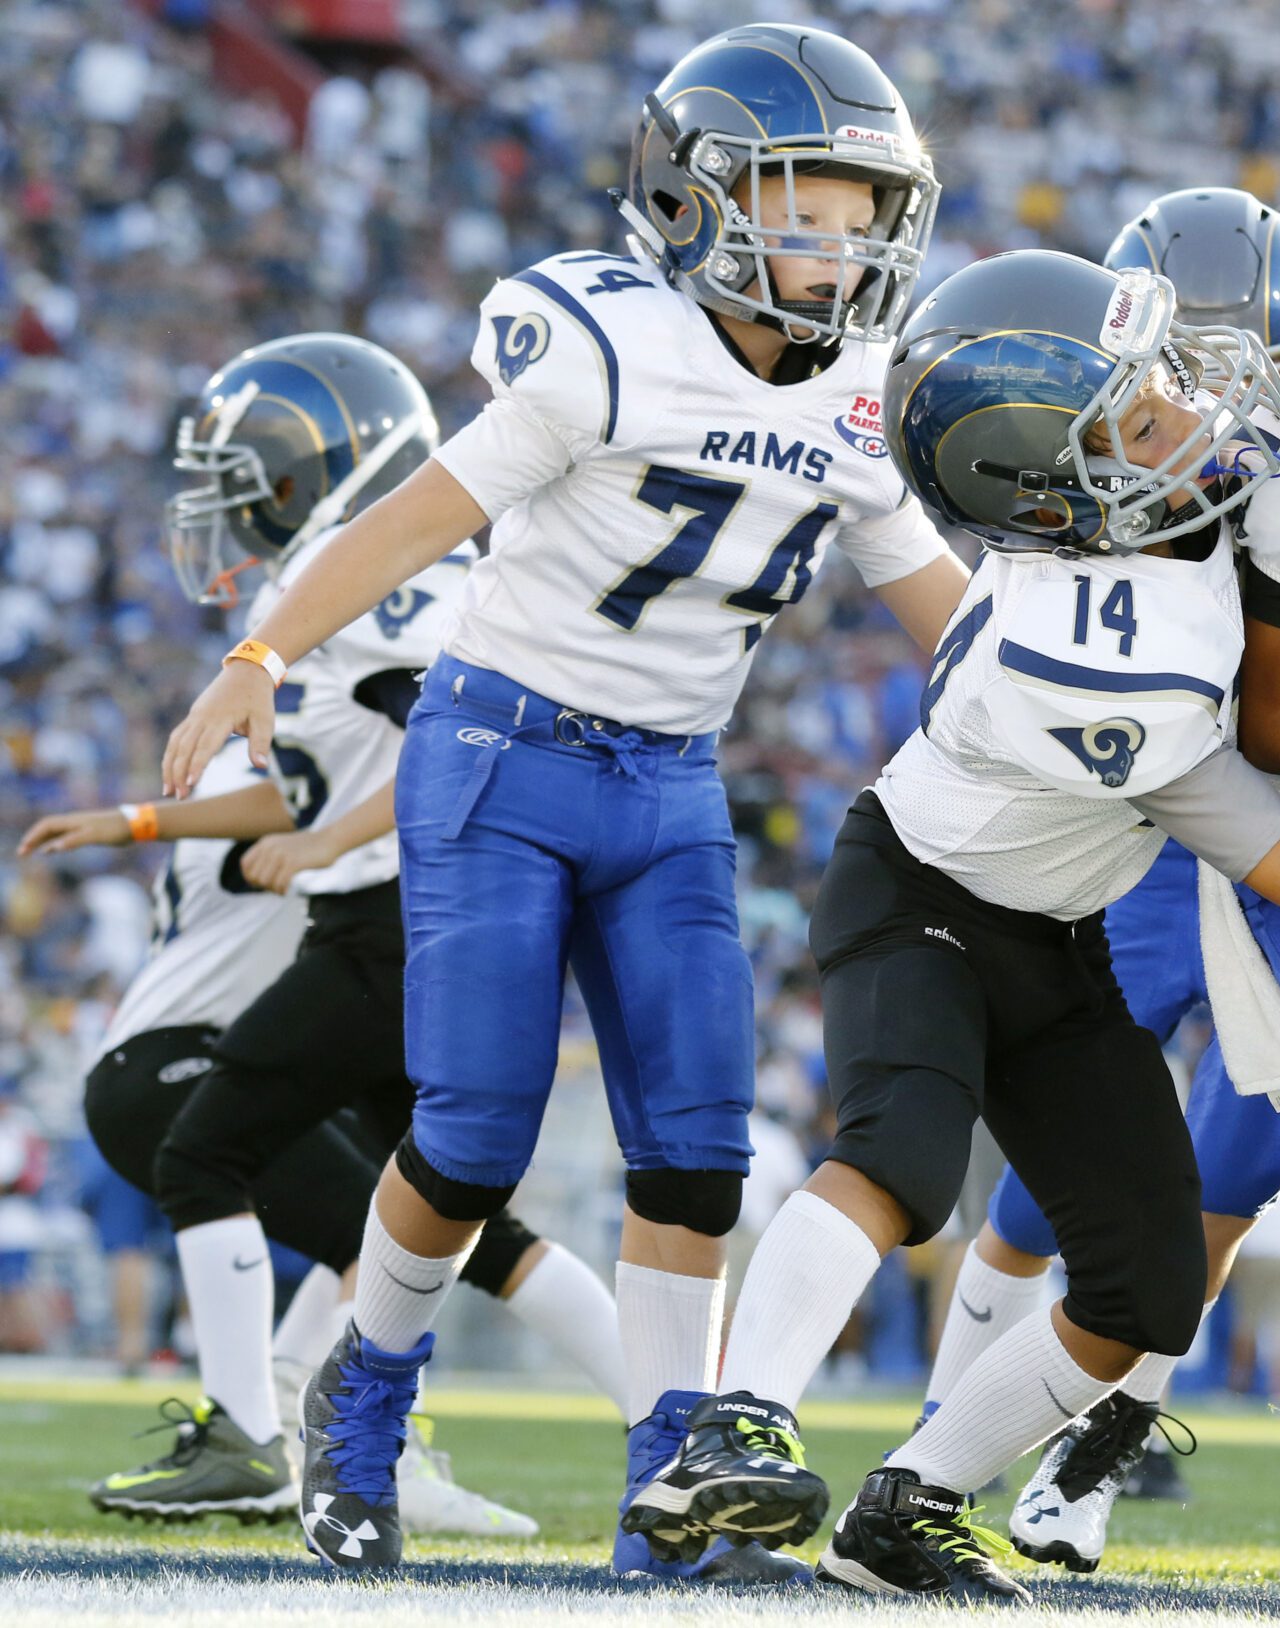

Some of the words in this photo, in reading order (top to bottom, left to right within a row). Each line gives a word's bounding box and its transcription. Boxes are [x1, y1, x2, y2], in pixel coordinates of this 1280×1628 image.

[1109, 289, 1133, 328] Riddell
[851, 396, 881, 417] PO
[848, 414, 883, 433] WARNE
[700, 431, 833, 483] RAMS
[589, 463, 842, 654] 74
[1073, 574, 1138, 658] 14
[717, 1403, 769, 1418] UNDER
[909, 1494, 953, 1512] UNDER
